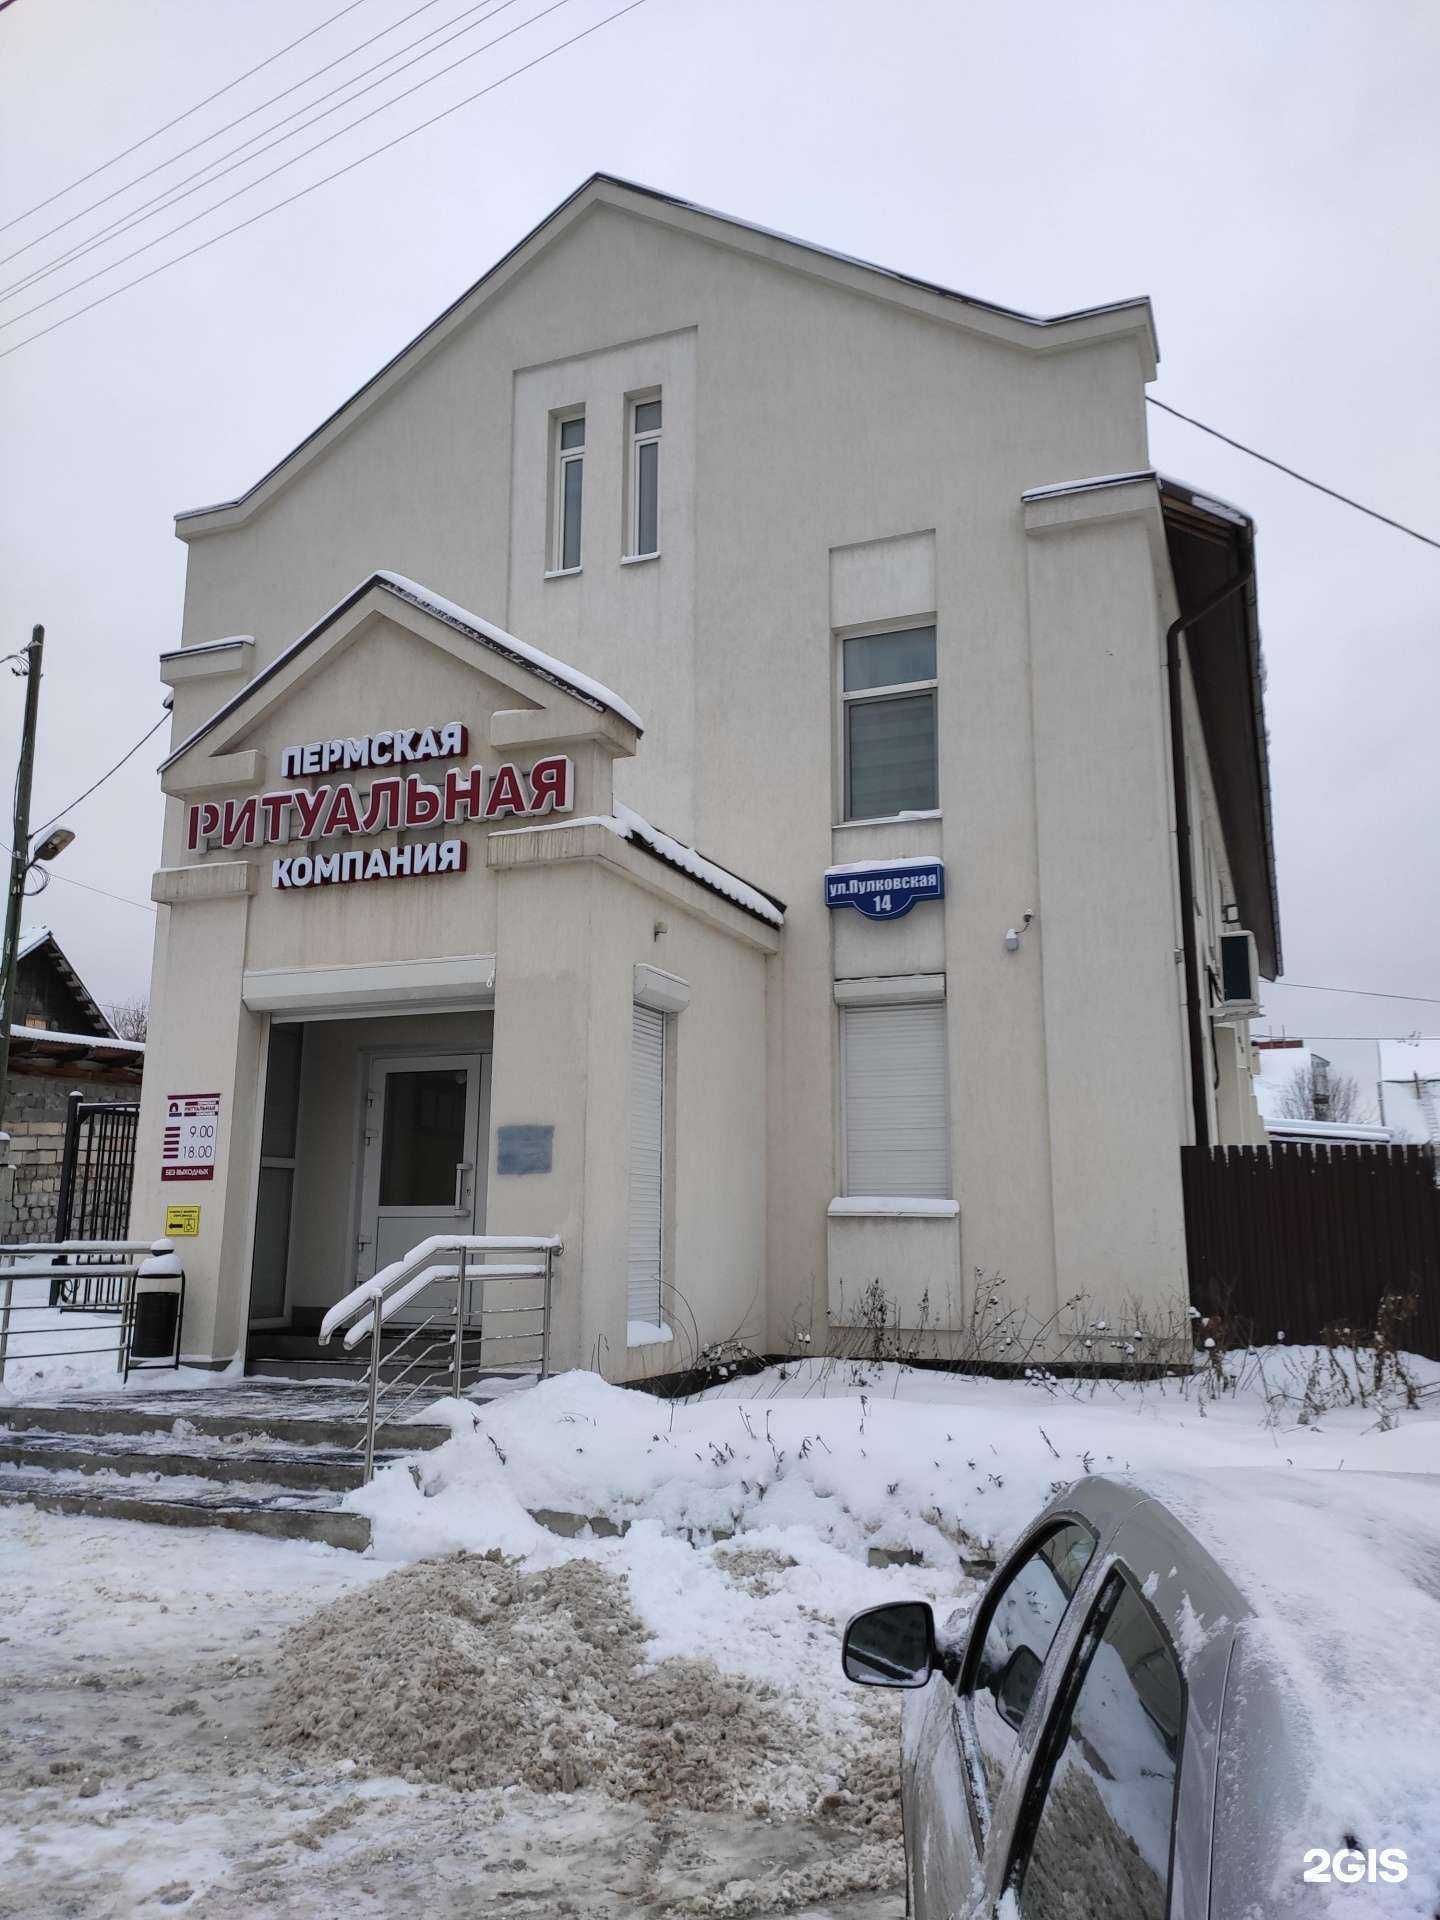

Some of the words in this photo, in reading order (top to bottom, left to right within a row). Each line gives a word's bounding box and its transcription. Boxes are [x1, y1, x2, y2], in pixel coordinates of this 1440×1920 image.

[281, 722, 466, 778] ПЕРМСКАЯ
[187, 755, 573, 852] РИТУАЛЬНАЯ
[272, 840, 466, 888] КОМПАНИЯ
[829, 874, 937, 897] ул.Пулковская
[873, 894, 892, 912] 14
[190, 1125, 214, 1138] 9.00
[183, 1145, 212, 1159] 18.00
[165, 1168, 176, 1176] БЕЗ
[176, 1168, 209, 1176] ВЫХОДНЫХ
